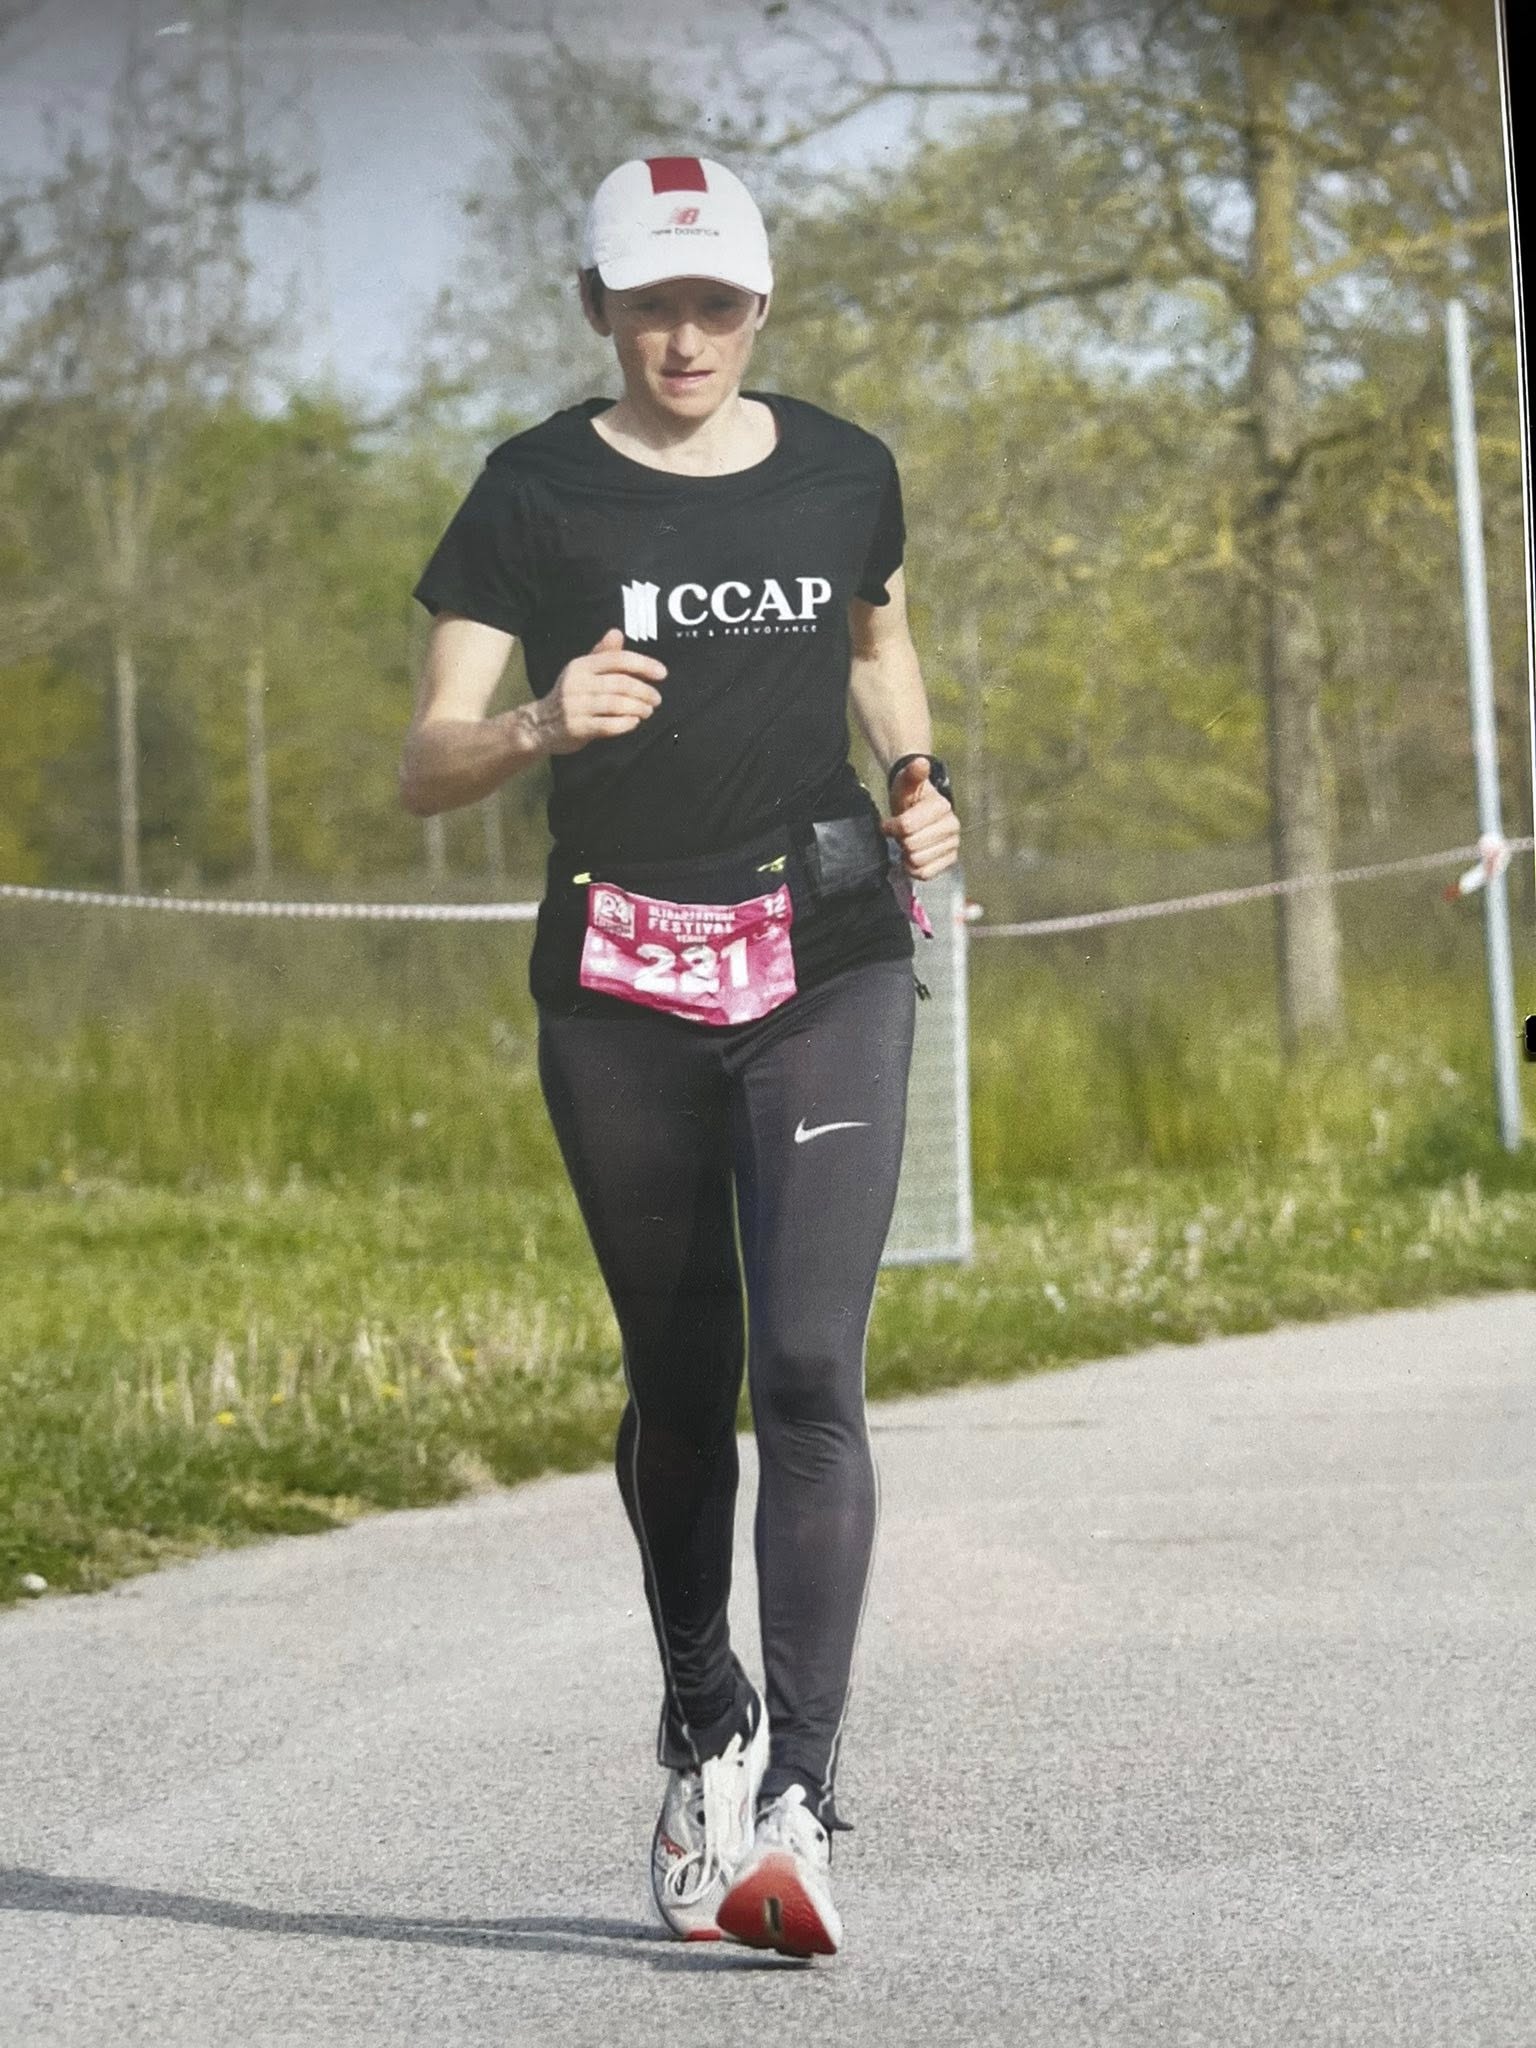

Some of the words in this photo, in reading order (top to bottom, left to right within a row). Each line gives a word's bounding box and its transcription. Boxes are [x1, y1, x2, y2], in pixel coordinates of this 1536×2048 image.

[668, 577, 832, 625] CCAP
[648, 917, 735, 935] FESTIVAL
[633, 937, 748, 993] 221
